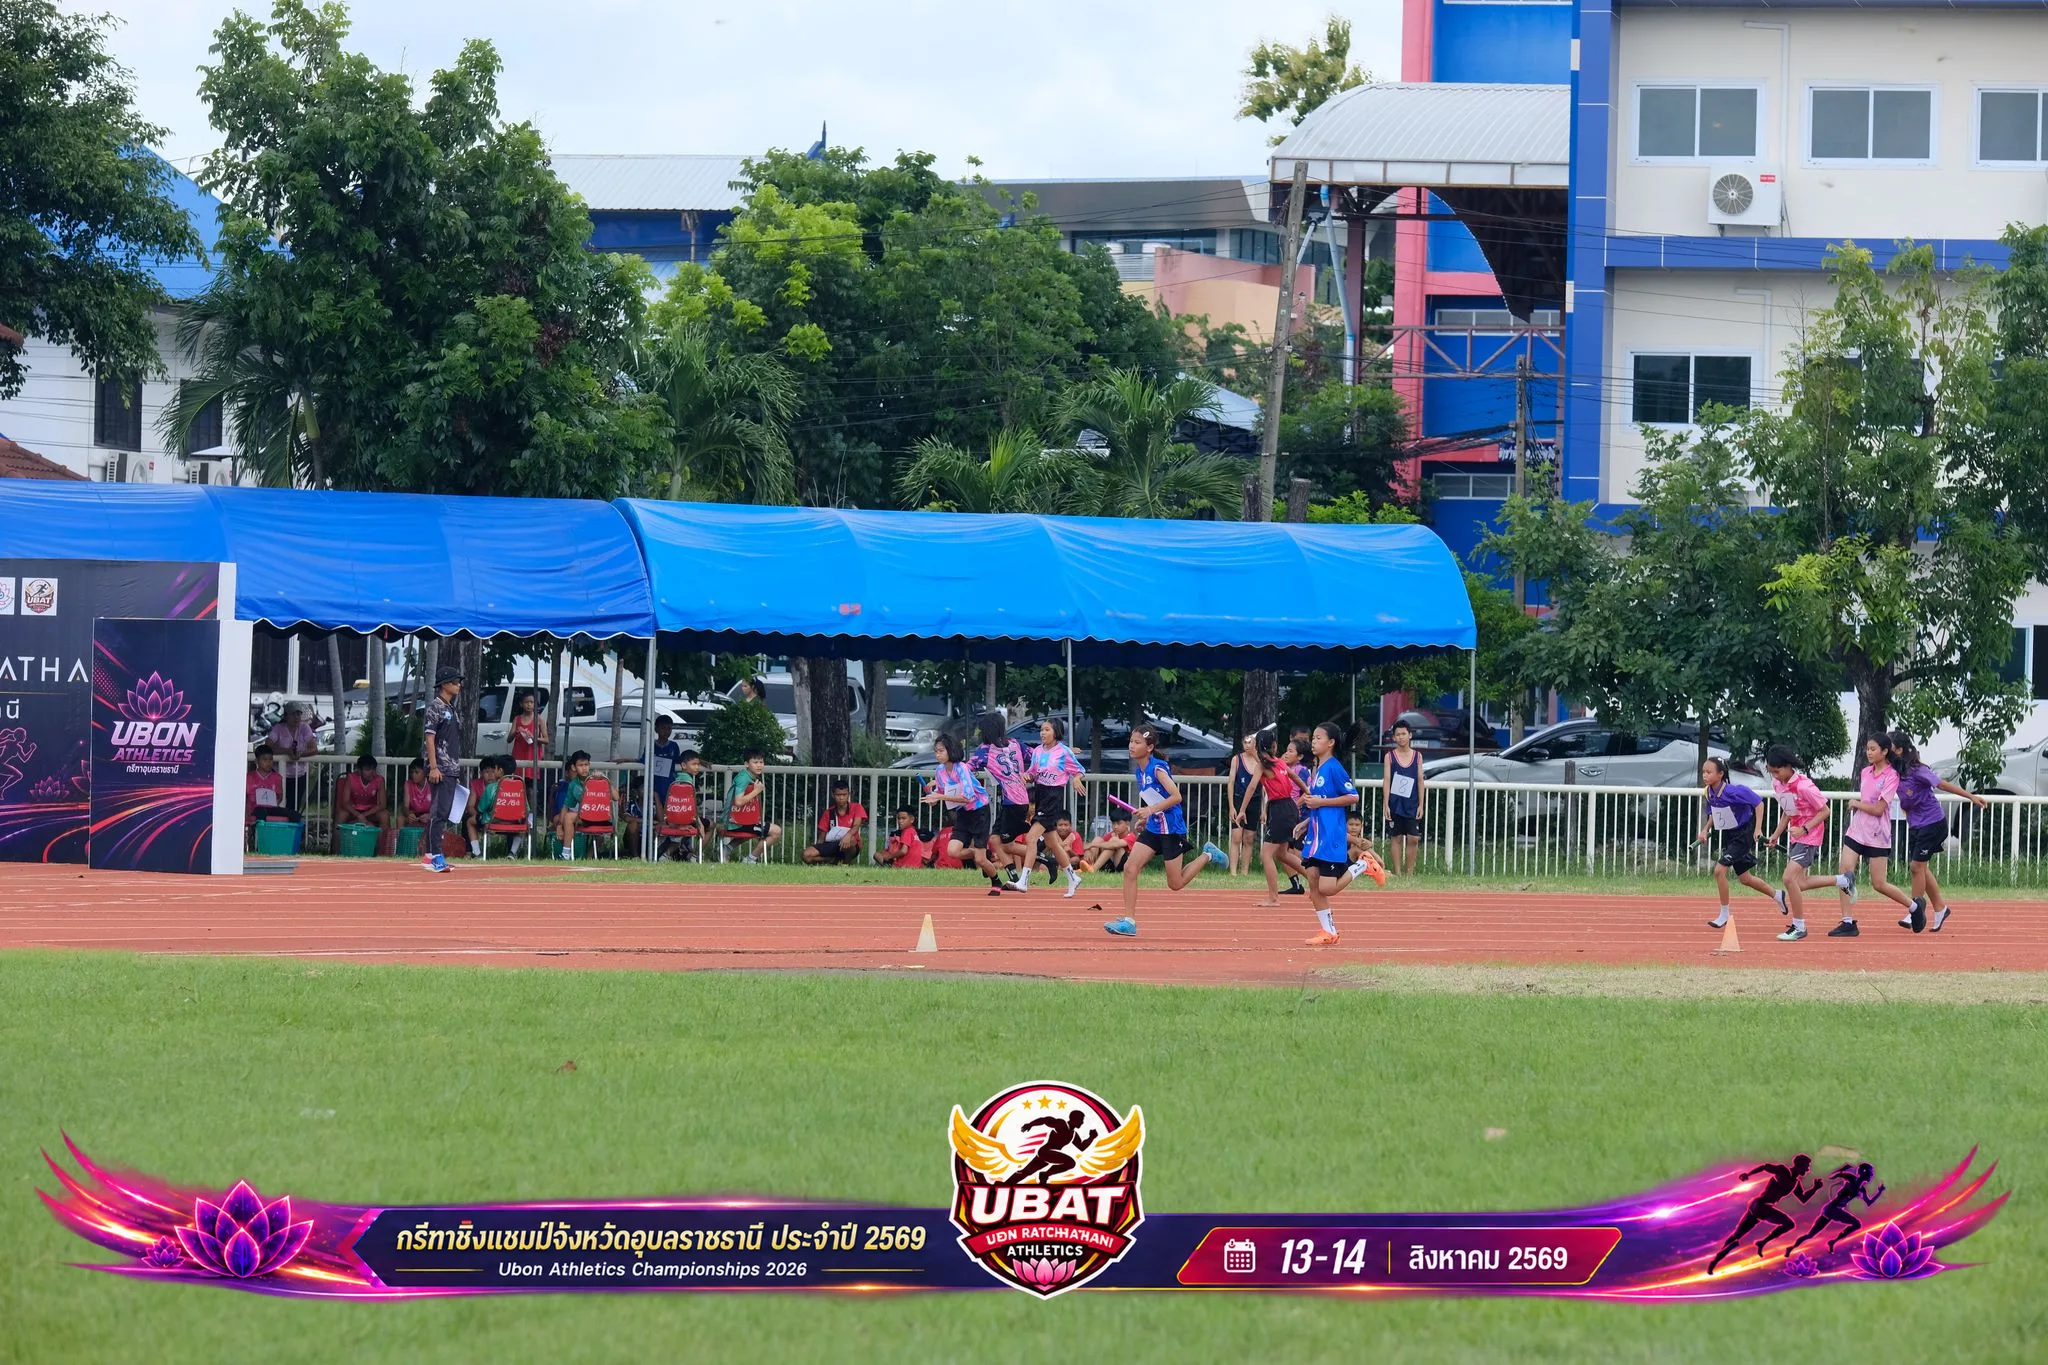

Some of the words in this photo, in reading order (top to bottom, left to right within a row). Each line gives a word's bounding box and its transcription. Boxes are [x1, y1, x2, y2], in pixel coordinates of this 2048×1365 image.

[111, 721, 200, 747] UBON
[111, 747, 196, 762] ATHLETICS
[1715, 811, 1726, 827] 3
